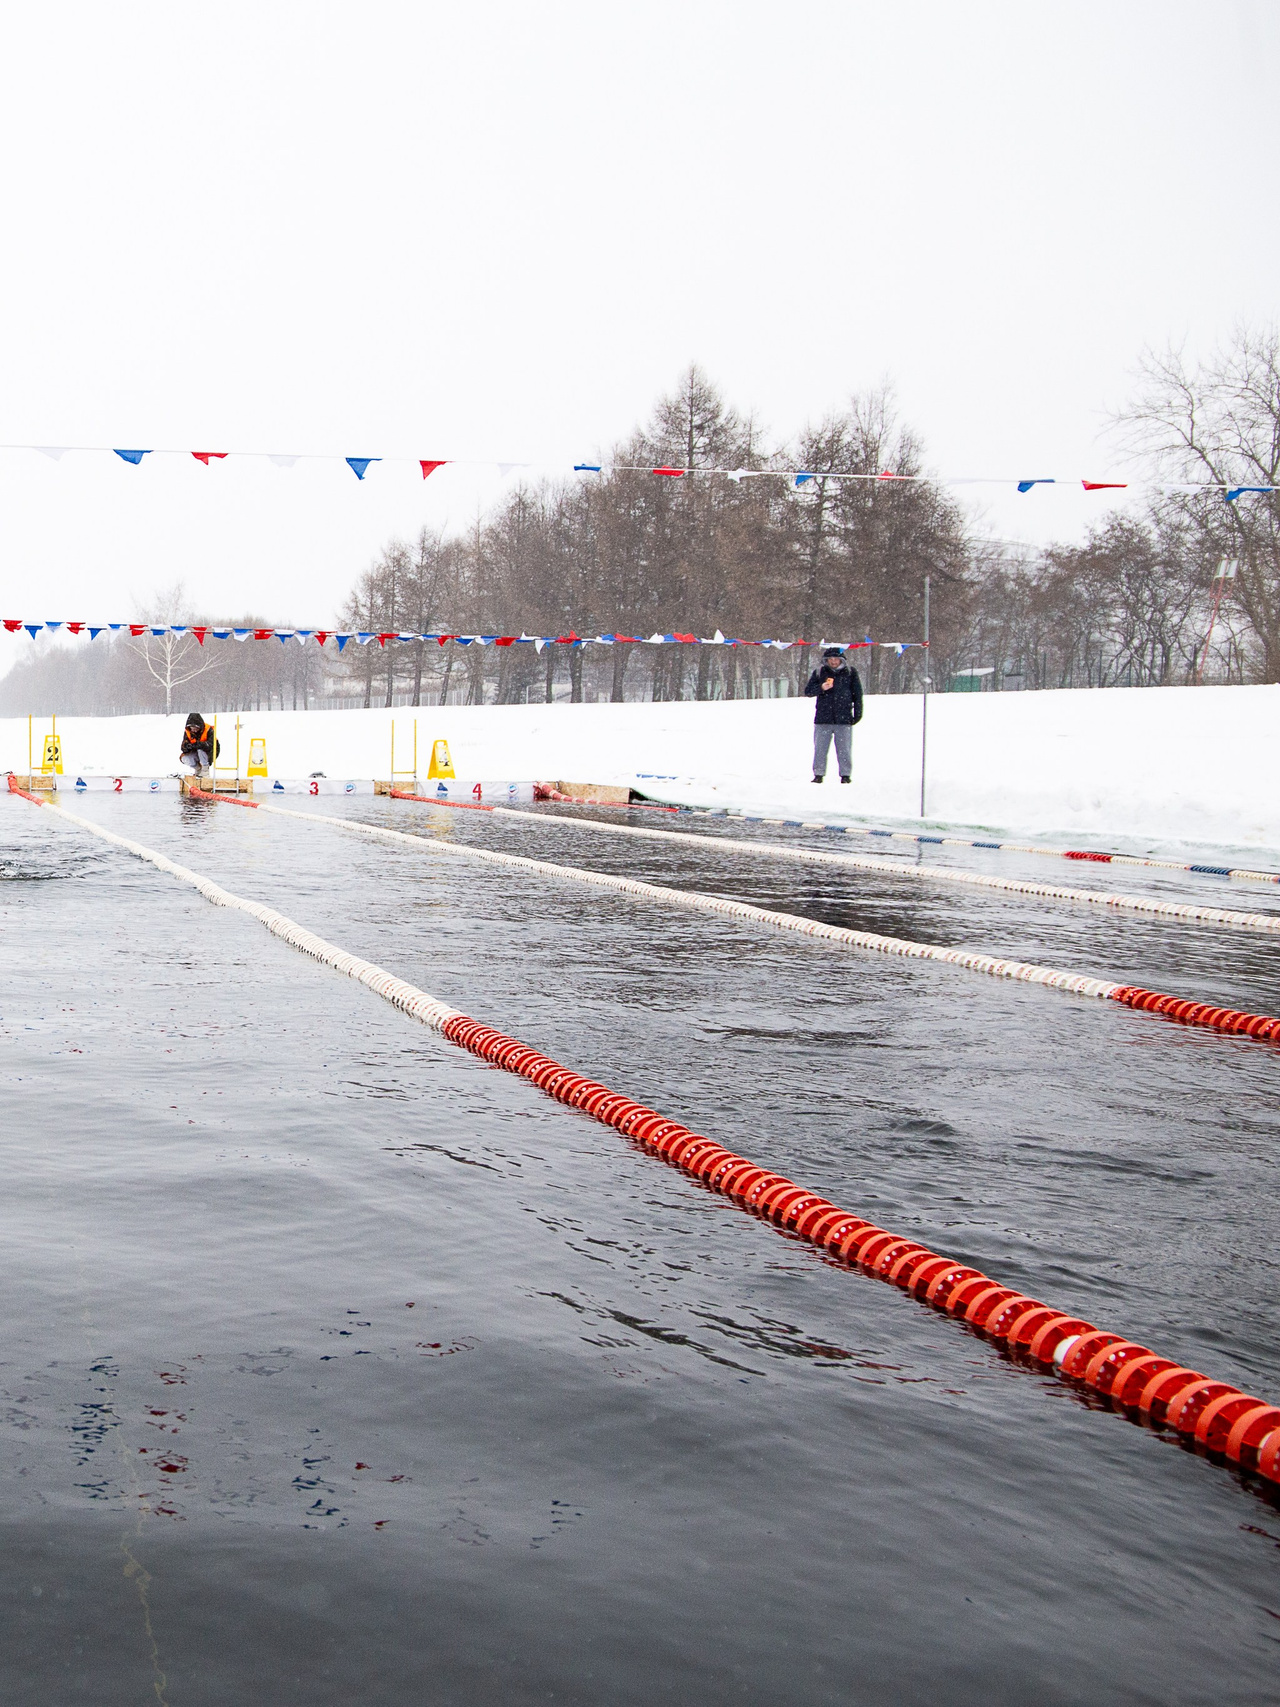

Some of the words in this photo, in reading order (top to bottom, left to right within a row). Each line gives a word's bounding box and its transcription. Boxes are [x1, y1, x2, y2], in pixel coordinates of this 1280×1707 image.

[47, 746, 59, 761] 2
[113, 778, 123, 791] 2
[309, 782, 319, 794] 3
[472, 783, 482, 795] 4
